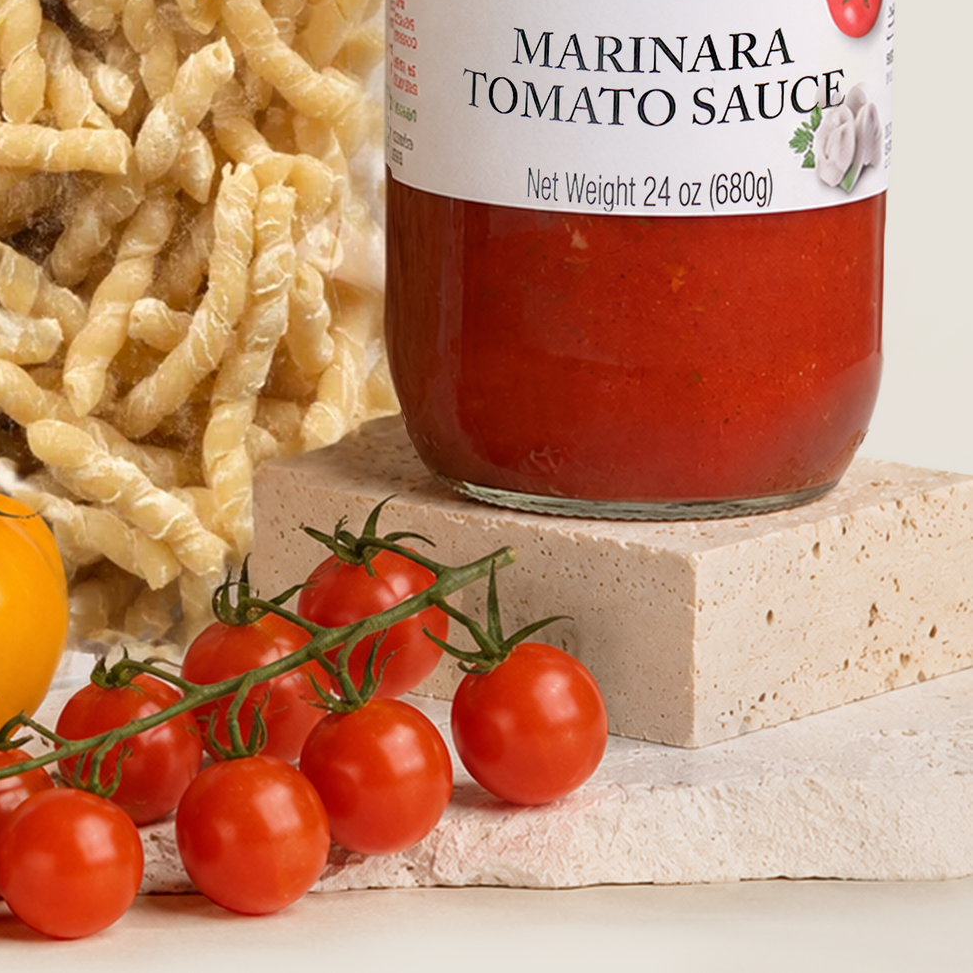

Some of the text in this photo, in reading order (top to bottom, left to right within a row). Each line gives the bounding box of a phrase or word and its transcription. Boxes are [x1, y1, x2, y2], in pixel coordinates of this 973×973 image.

[512, 27, 795, 74] MARINARA
[462, 67, 677, 127] TOMATO
[692, 68, 846, 126] SAUCE
[527, 167, 773, 212] Net Weight 24 oz (680g)
